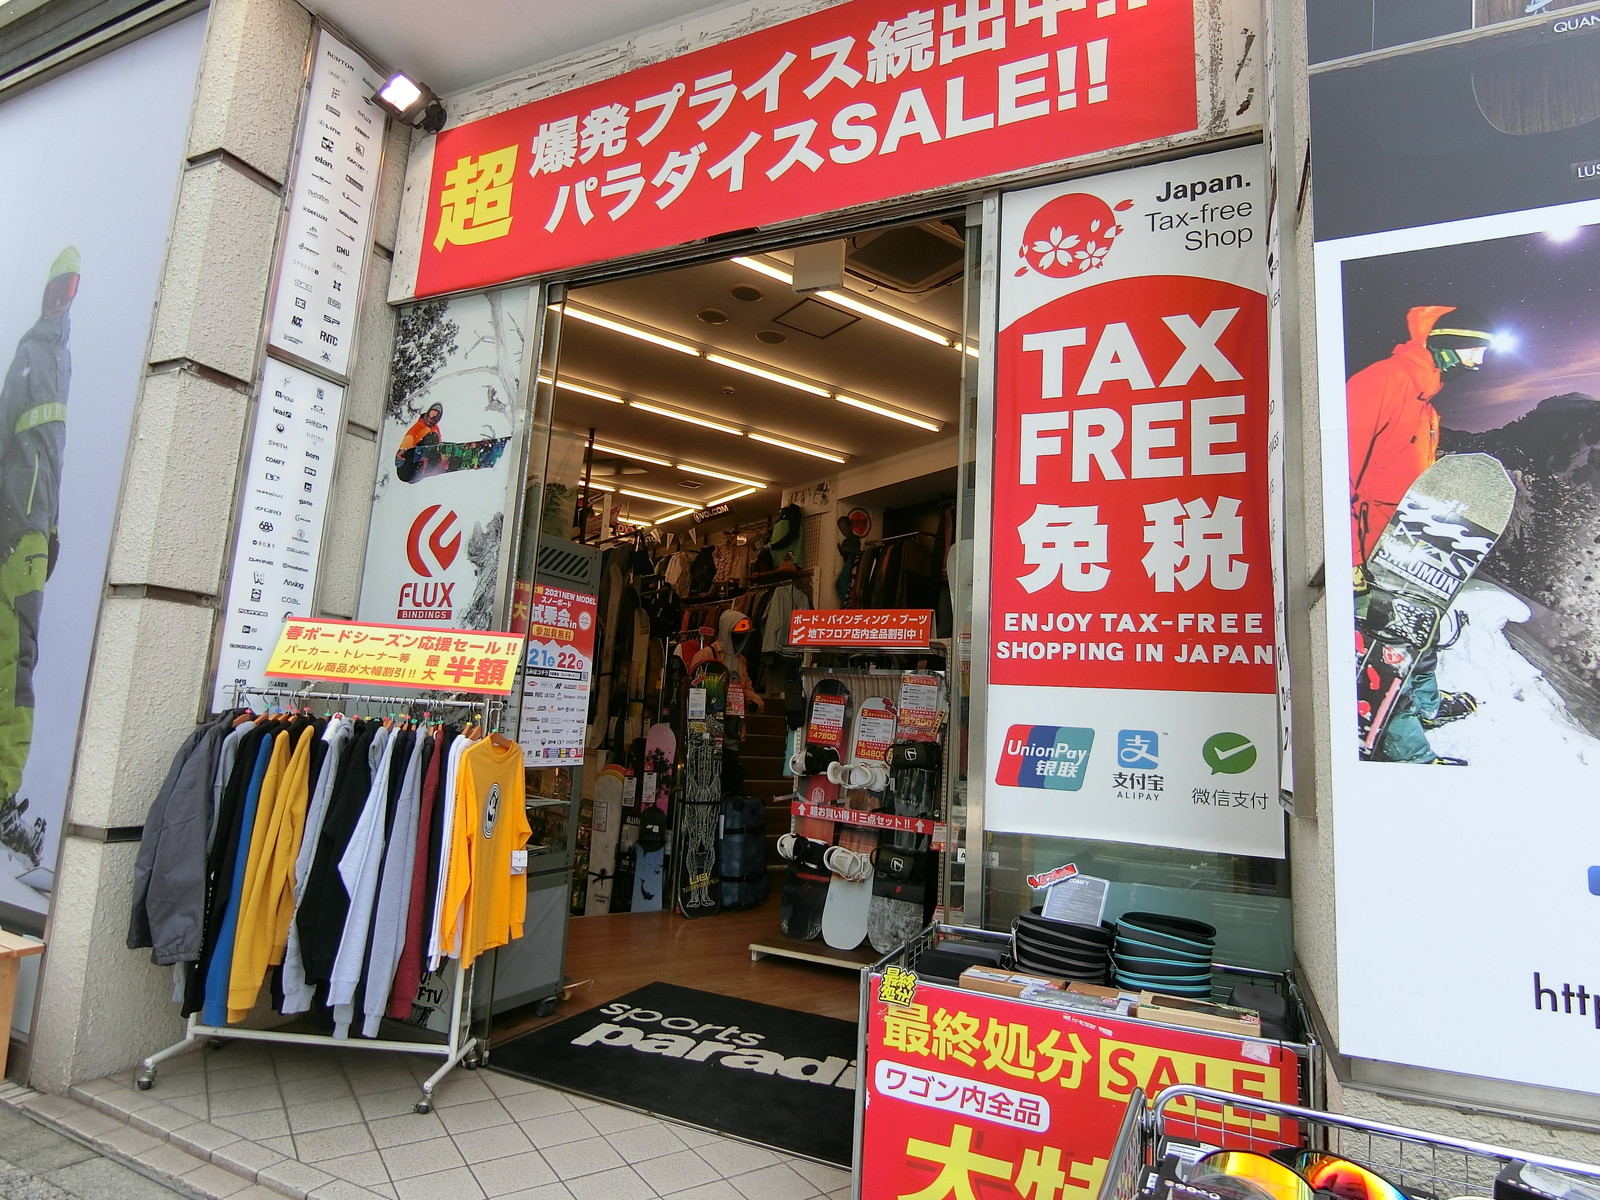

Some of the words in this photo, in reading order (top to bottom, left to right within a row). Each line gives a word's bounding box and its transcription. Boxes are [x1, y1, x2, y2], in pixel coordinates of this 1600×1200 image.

[327, 51, 354, 71] BURTON
[546, 38, 1109, 232] パラダイスSALE!!
[314, 156, 332, 169] elan
[433, 145, 518, 252] 超
[1156, 173, 1251, 203] Japan.
[1145, 201, 1253, 232] Tax-free
[1184, 226, 1253, 251] Shop
[336, 246, 350, 256] GNU
[1022, 307, 1244, 400] TAX
[268, 440, 288, 450] SMITH
[1019, 395, 1247, 485] FREE
[266, 456, 285, 466] COMFY
[700, 504, 729, 520] VOLCOM
[259, 520, 274, 532] 686
[1016, 495, 1249, 594] 免税
[248, 557, 274, 566] DAKINE
[284, 579, 304, 590] Analog
[398, 582, 456, 608] FLUX
[542, 596, 572, 608] スノーボード
[576, 595, 596, 606] MODEL
[402, 610, 447, 618] BINDINGS
[1004, 613, 1092, 632] ENJOY
[1100, 613, 1263, 634] TAX-FREE
[286, 626, 518, 656] 春ボードシーズン応援セール!!
[808, 628, 923, 640] 地下フロア店内全品割引中!
[996, 641, 1124, 661] SHOPPING
[1136, 643, 1163, 662] IN
[1174, 643, 1273, 665] JAPAN
[279, 658, 416, 680] アパレル商品が大幅割引!!
[284, 644, 410, 662] パーカー・トレーナー等
[444, 656, 508, 686] 半額
[813, 732, 836, 740] 47800
[1007, 739, 1087, 766] UnionPay
[1035, 759, 1078, 778] 银联
[1112, 771, 1164, 792] 支付宝
[1116, 791, 1160, 801] ALIPAY
[1191, 787, 1269, 810] 微信支付
[600, 1002, 767, 1046] sports
[883, 1003, 1093, 1089] 最終処分
[886, 1068, 1041, 1127] ワゴン内全品
